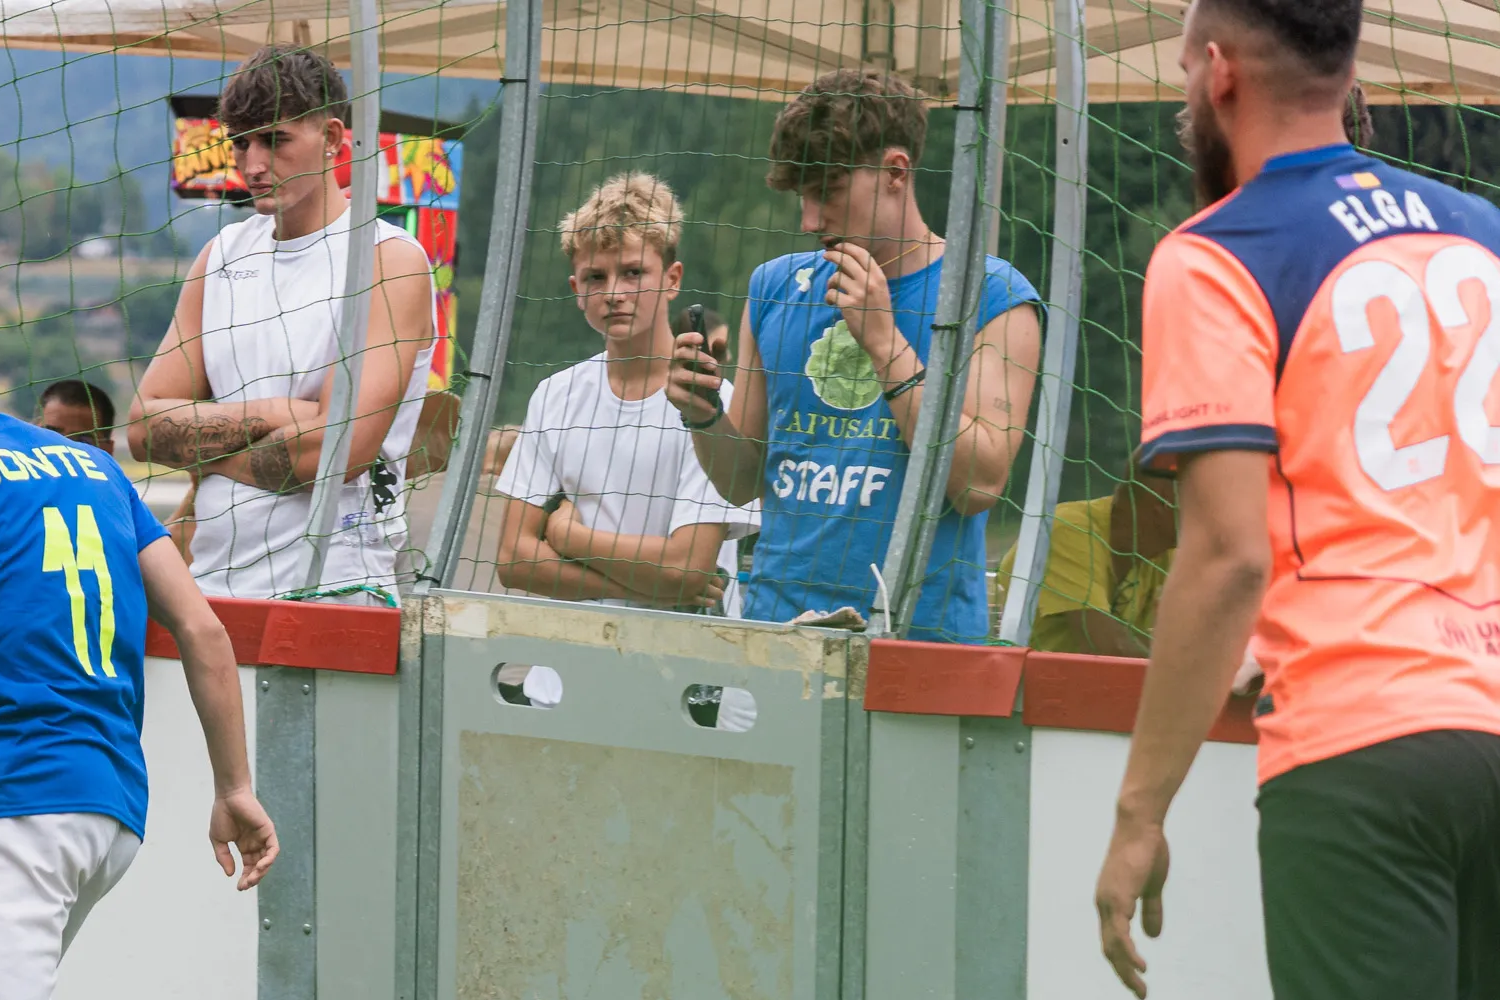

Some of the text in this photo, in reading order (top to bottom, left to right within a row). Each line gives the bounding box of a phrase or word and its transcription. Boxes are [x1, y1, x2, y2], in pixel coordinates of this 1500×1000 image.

[1328, 189, 1439, 243] ELGA
[1332, 245, 1500, 491] 22
[774, 409, 902, 441] APUSAT
[772, 459, 892, 507] STAFF
[42, 504, 117, 678] 11
